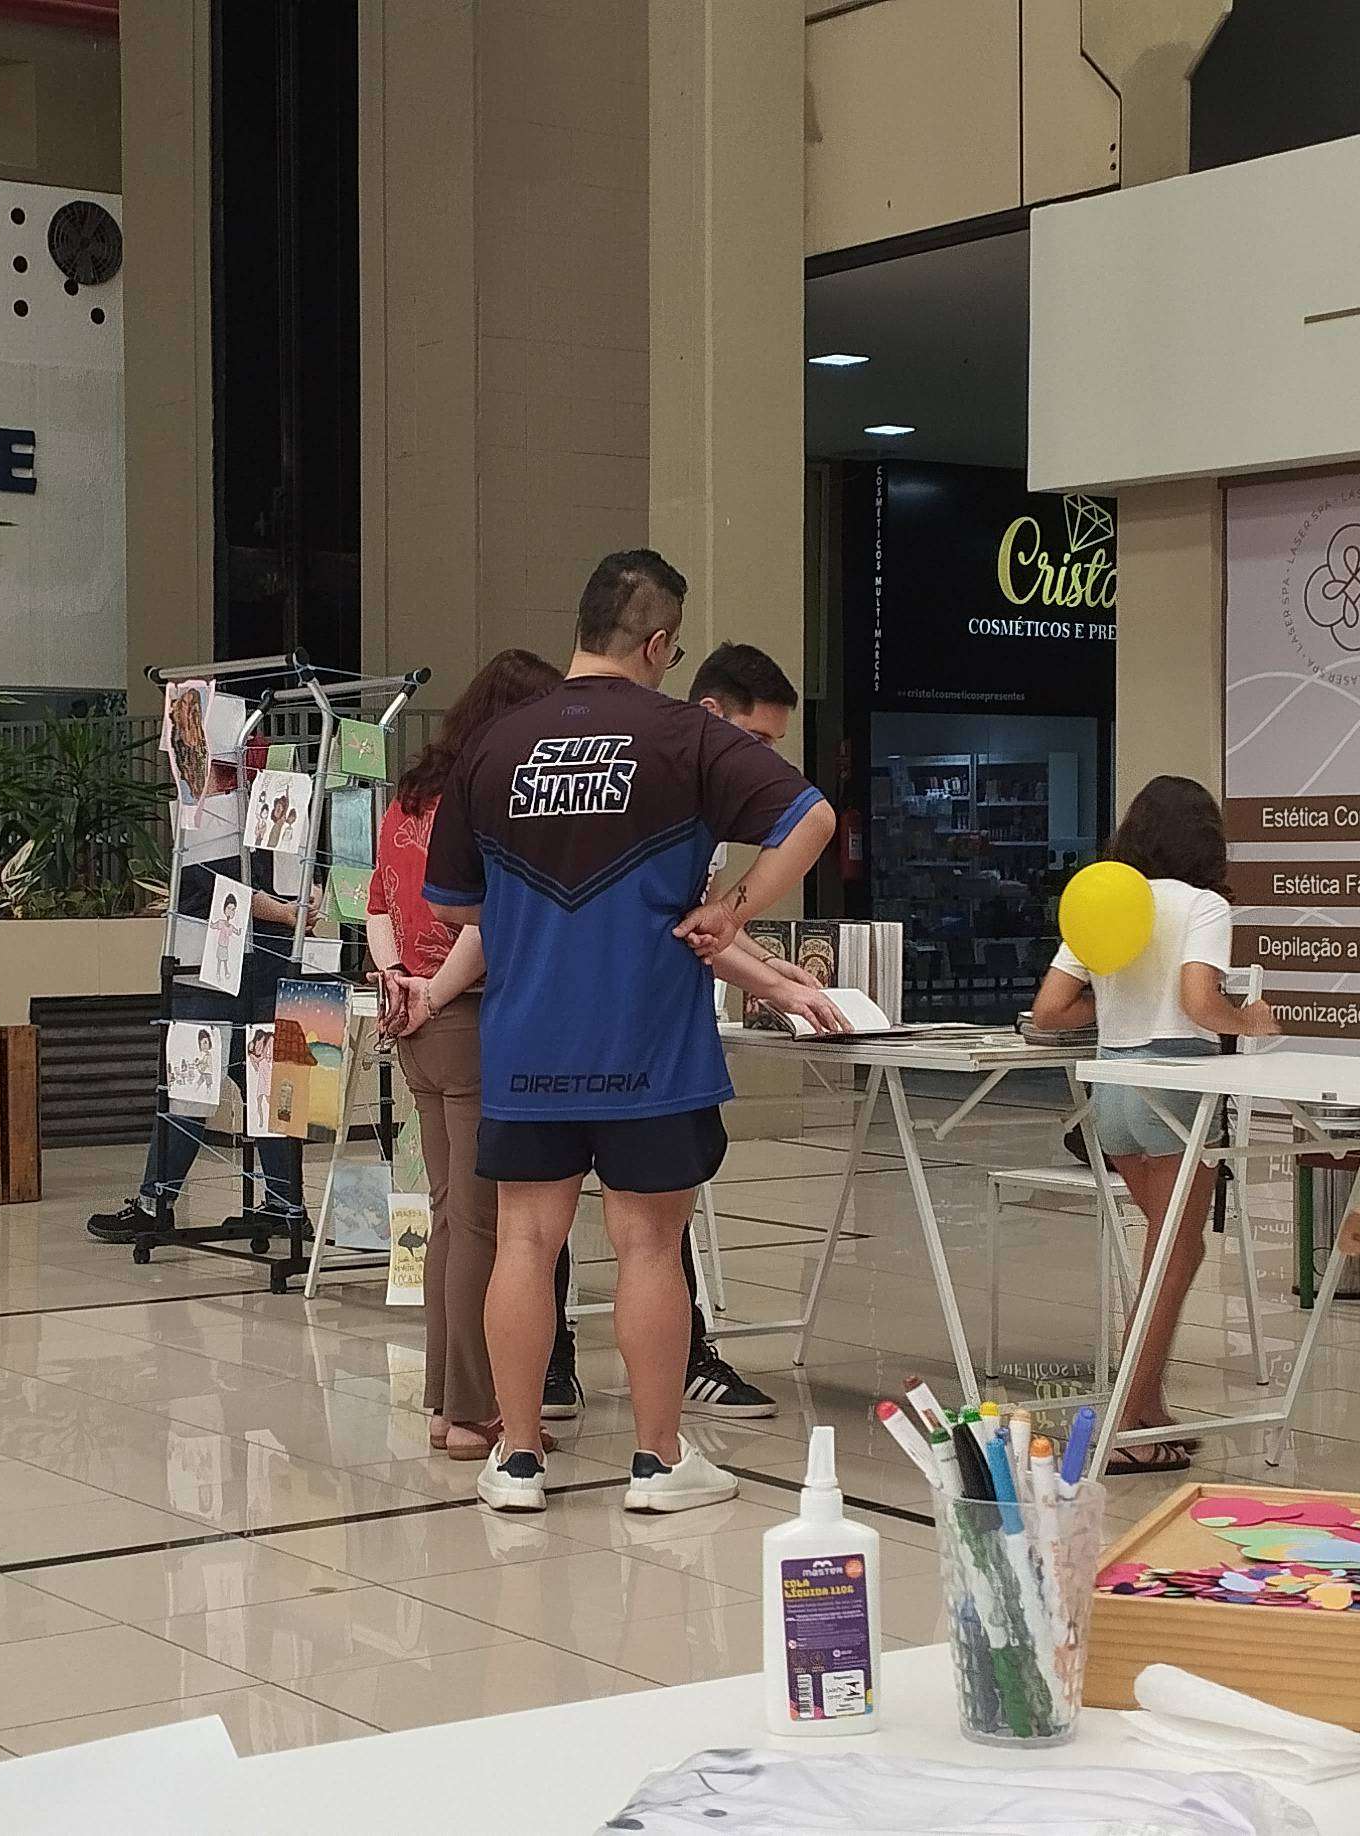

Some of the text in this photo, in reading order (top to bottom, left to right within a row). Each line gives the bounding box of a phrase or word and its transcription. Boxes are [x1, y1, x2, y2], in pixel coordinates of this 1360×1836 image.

[968, 616, 1070, 638] COSMÉTICOS
[1075, 624, 1084, 639] E
[530, 737, 632, 764] SUIT
[509, 761, 637, 818] SHARKS
[1262, 807, 1329, 829] Estética
[1273, 875, 1340, 895] Estética
[1258, 936, 1342, 961] Depilação
[1347, 943, 1358, 957] a
[510, 1072, 651, 1093] DIRETORIA
